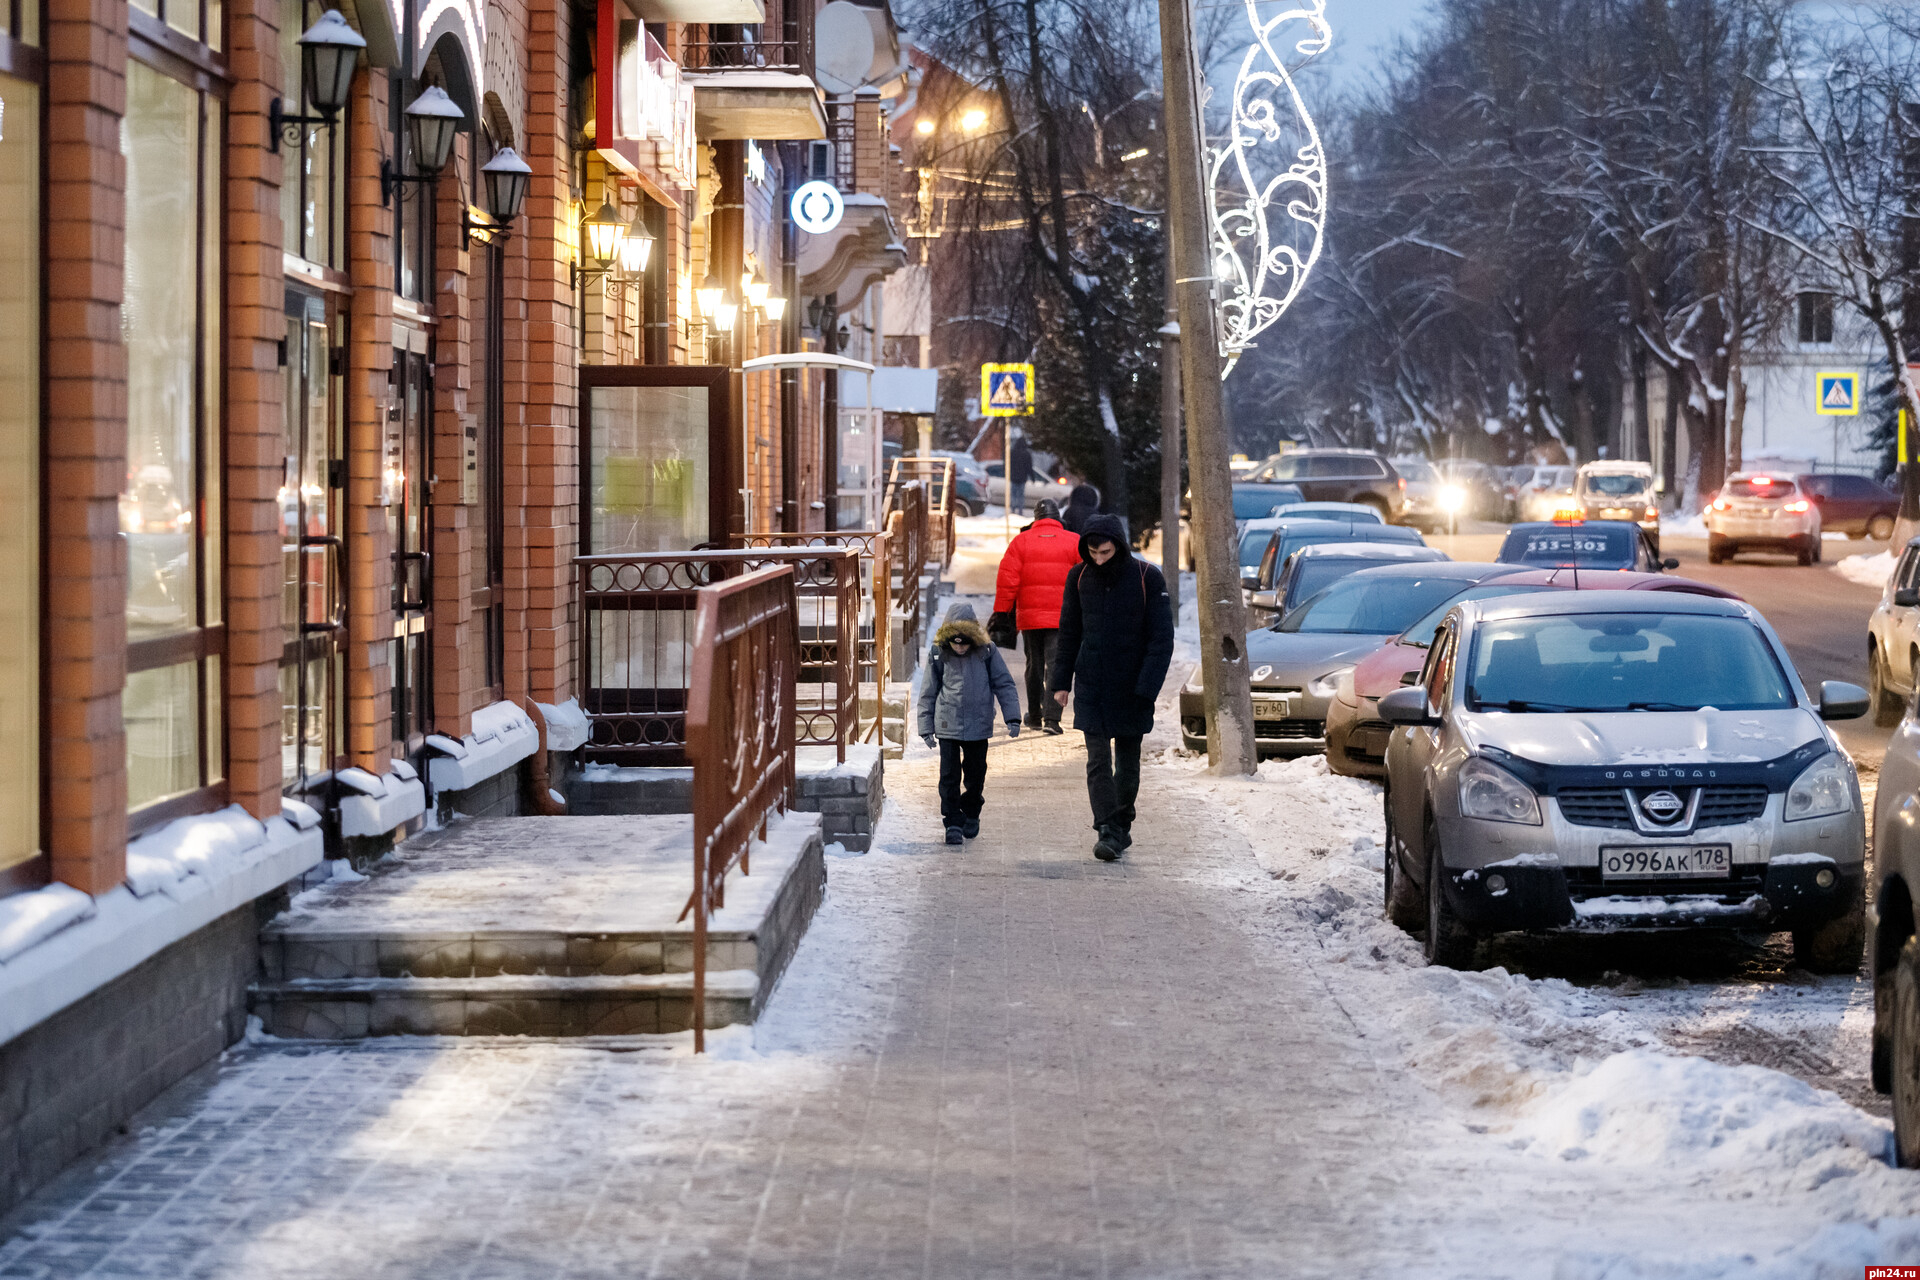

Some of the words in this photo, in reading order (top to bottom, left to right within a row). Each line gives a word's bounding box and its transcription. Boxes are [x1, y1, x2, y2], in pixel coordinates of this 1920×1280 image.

[1528, 541, 1606, 552] 333-303
[1271, 702, 1282, 713] 60
[1694, 849, 1723, 865] 178
